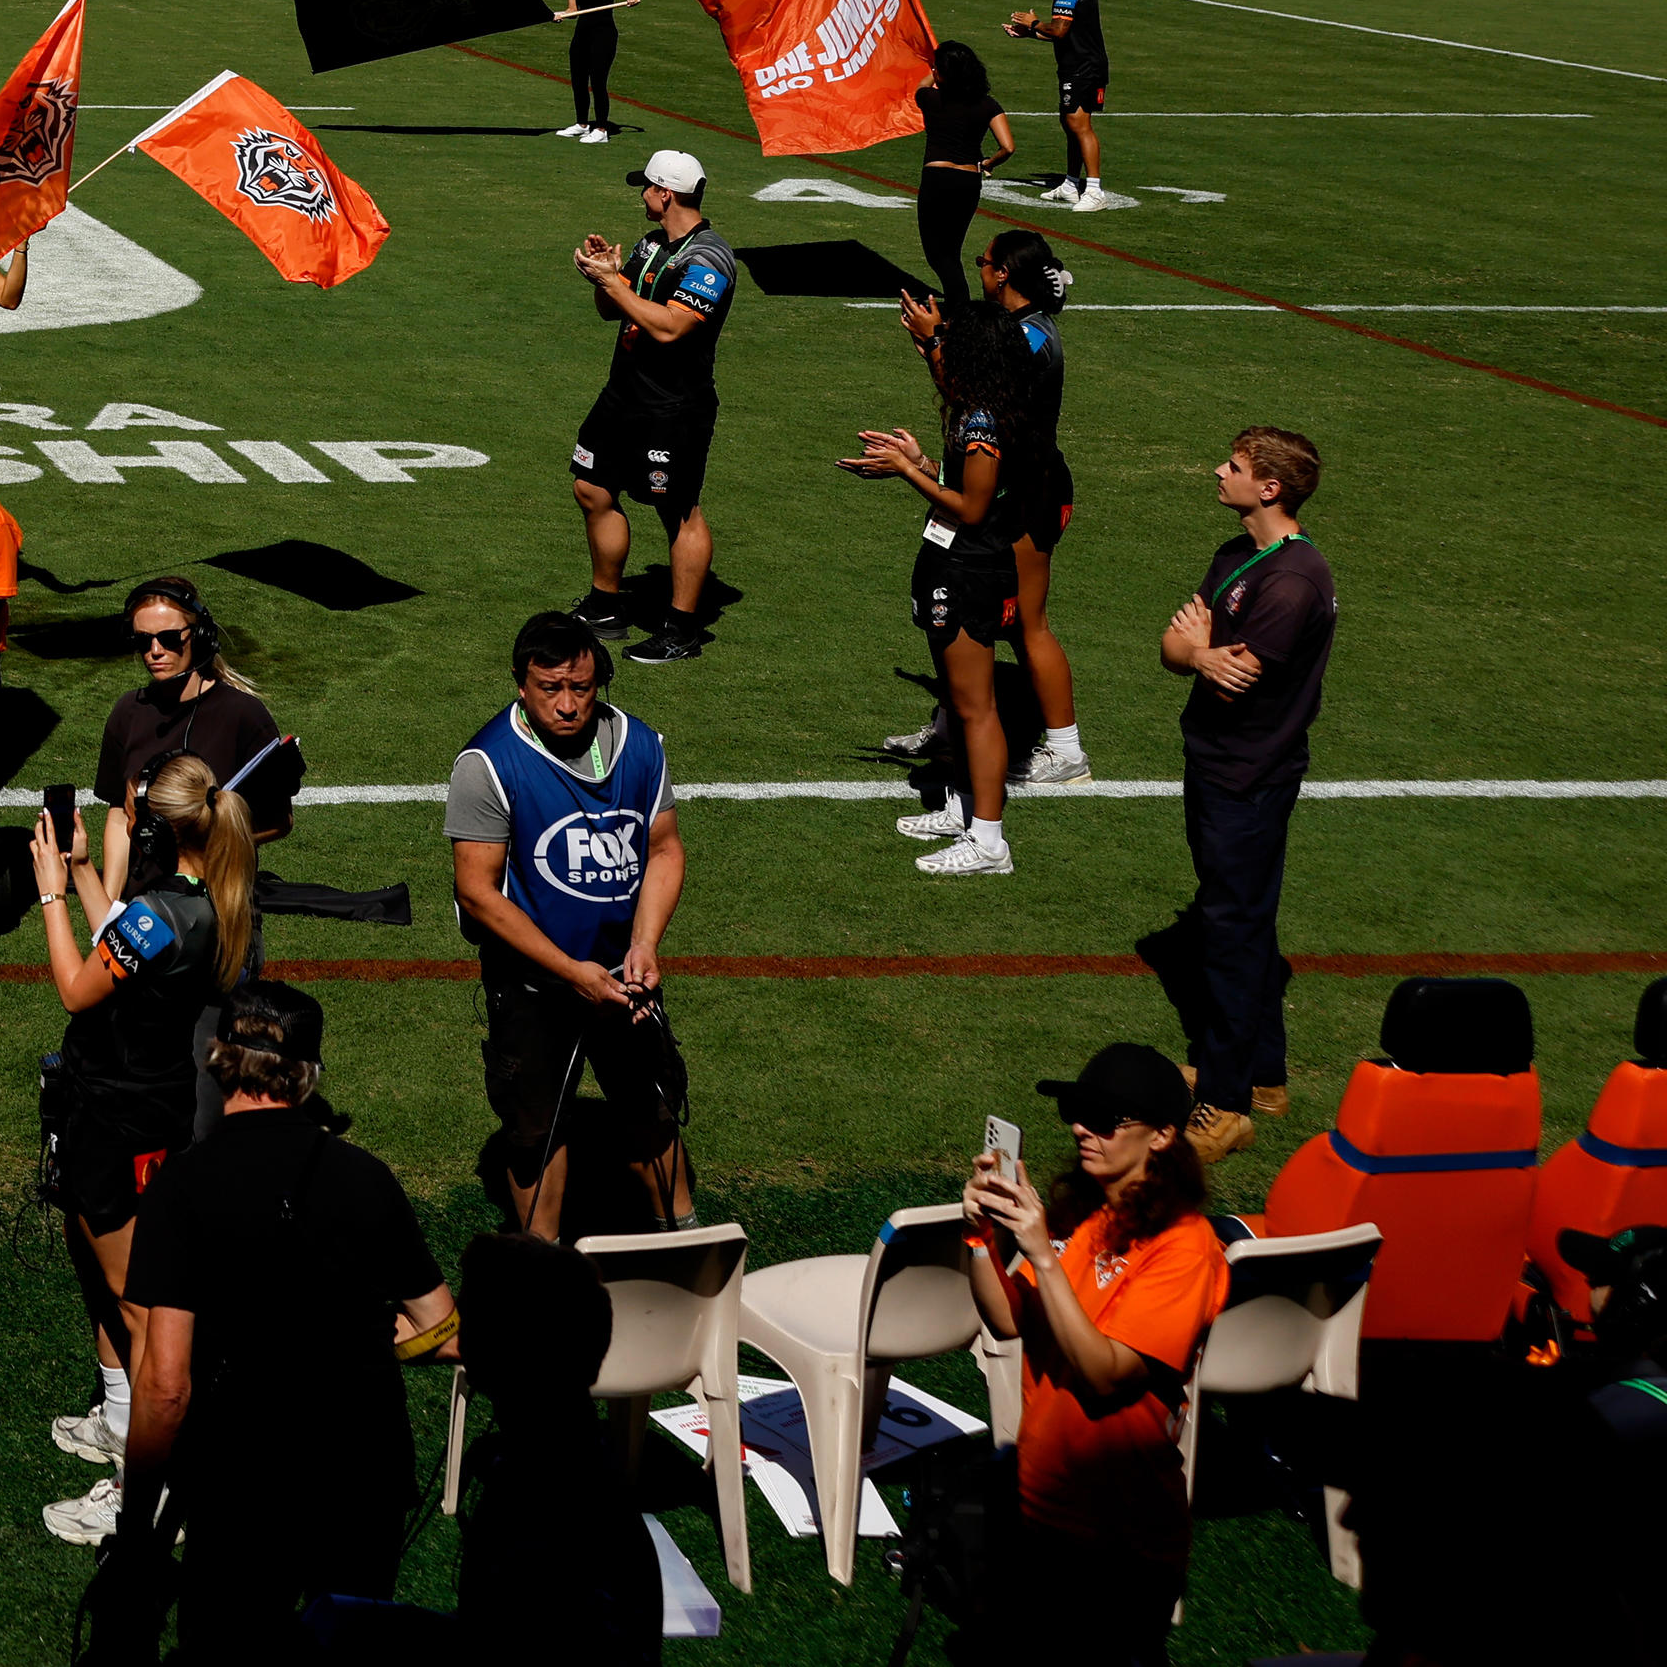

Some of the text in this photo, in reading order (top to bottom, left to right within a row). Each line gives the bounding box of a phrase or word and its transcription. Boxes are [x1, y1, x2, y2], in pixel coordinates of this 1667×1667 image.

[755, 41, 815, 87] ONE
[761, 76, 815, 98] NO
[689, 281, 719, 298] ZURICH
[566, 823, 639, 870] FOX
[568, 862, 639, 885] SPORTS
[121, 920, 151, 950] ZURICH
